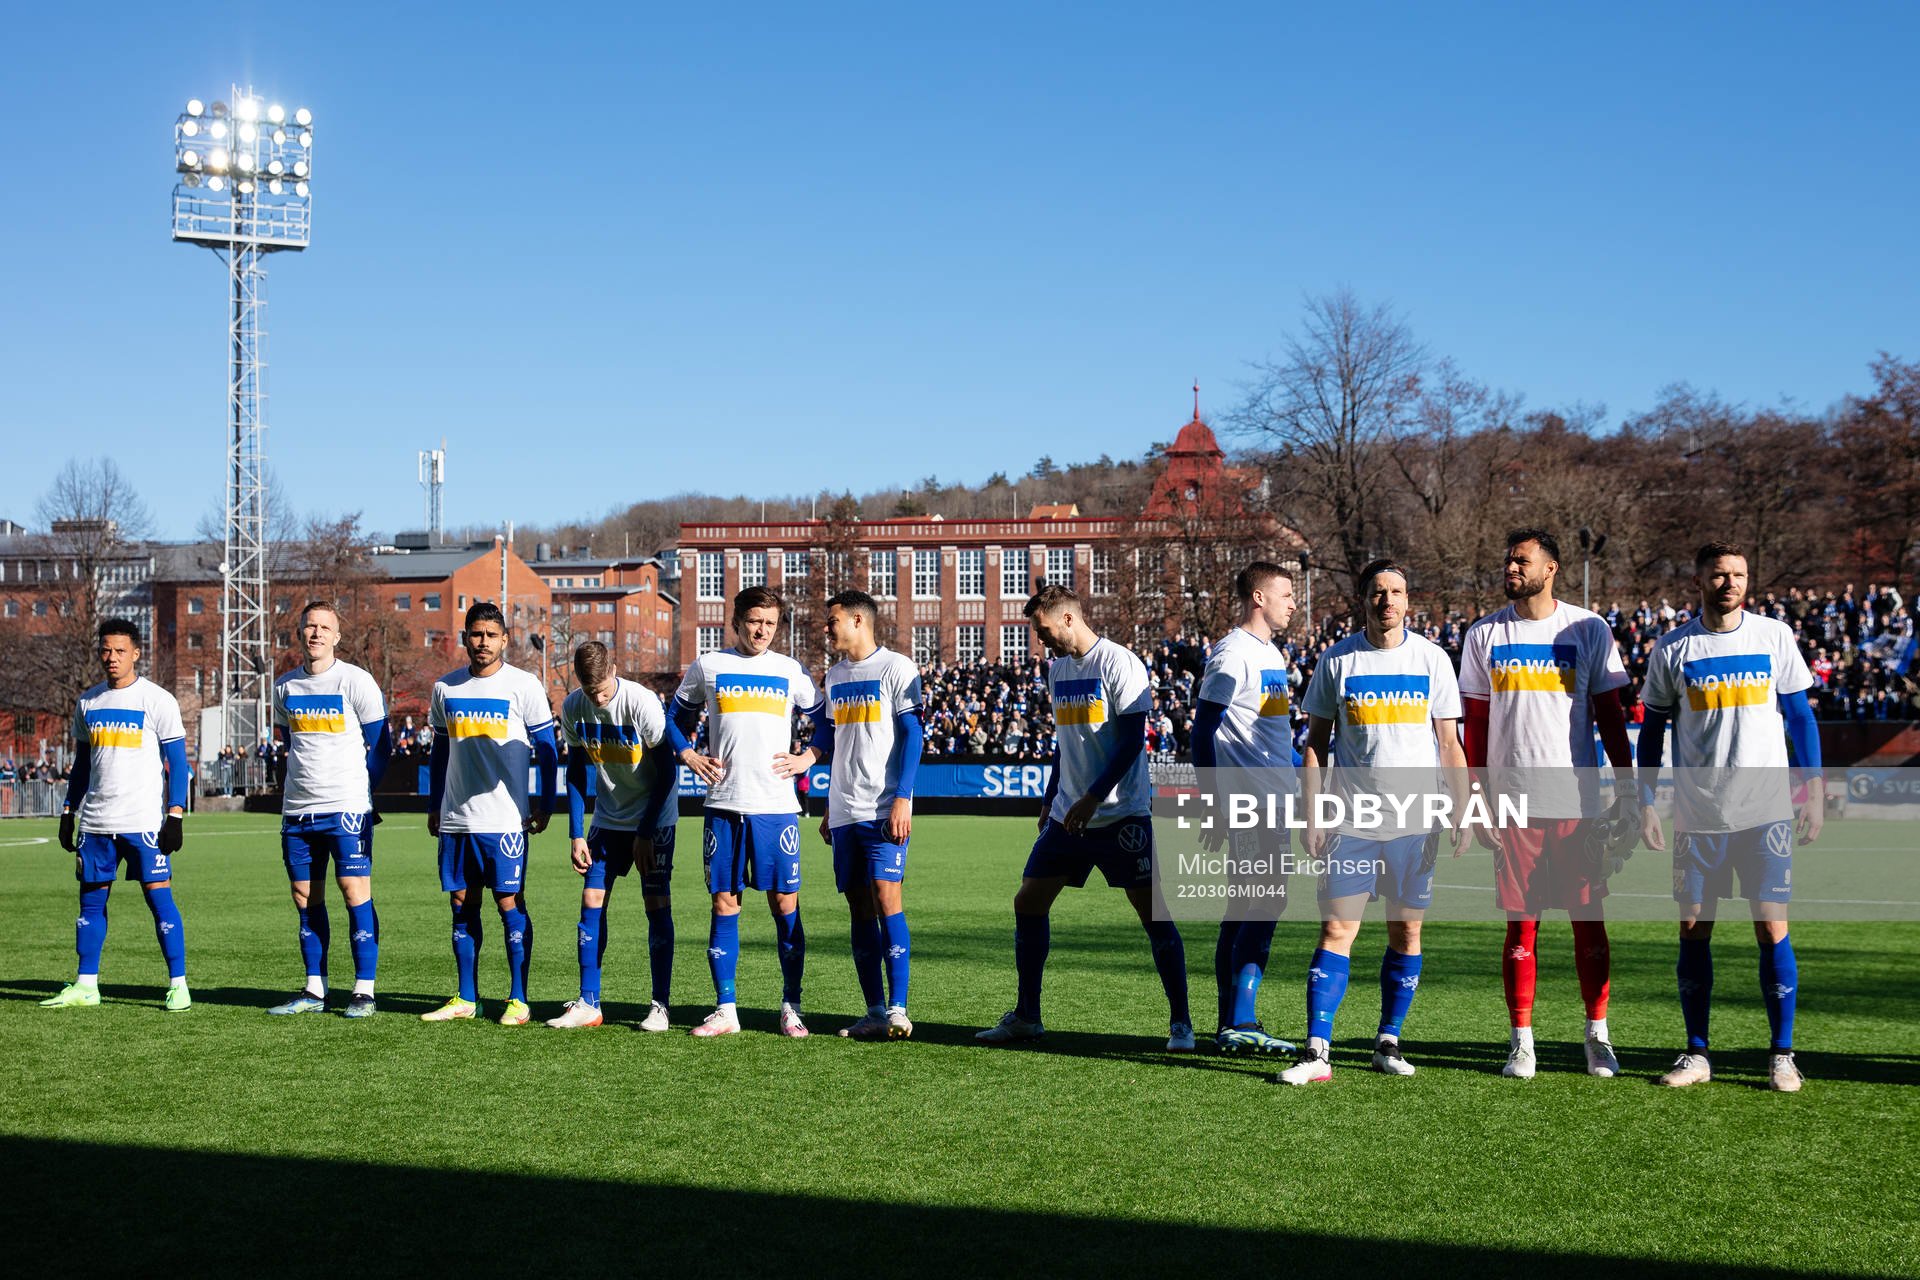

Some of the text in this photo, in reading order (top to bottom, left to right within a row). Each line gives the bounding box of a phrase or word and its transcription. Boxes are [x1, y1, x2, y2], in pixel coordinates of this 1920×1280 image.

[1494, 658, 1571, 675] NO WAR
[1690, 672, 1768, 691] NO WAR
[719, 685, 785, 702] NO WAR
[847, 694, 876, 708] WAR
[1350, 690, 1425, 707] NO WAR
[1055, 693, 1097, 710] NO WAR
[306, 708, 339, 720] WAR
[447, 710, 505, 725] NO WAR
[106, 721, 139, 734] WAR
[1149, 752, 1176, 763] THE
[155, 854, 167, 867] 22
[895, 852, 902, 866] 5
[1136, 857, 1151, 872] 30
